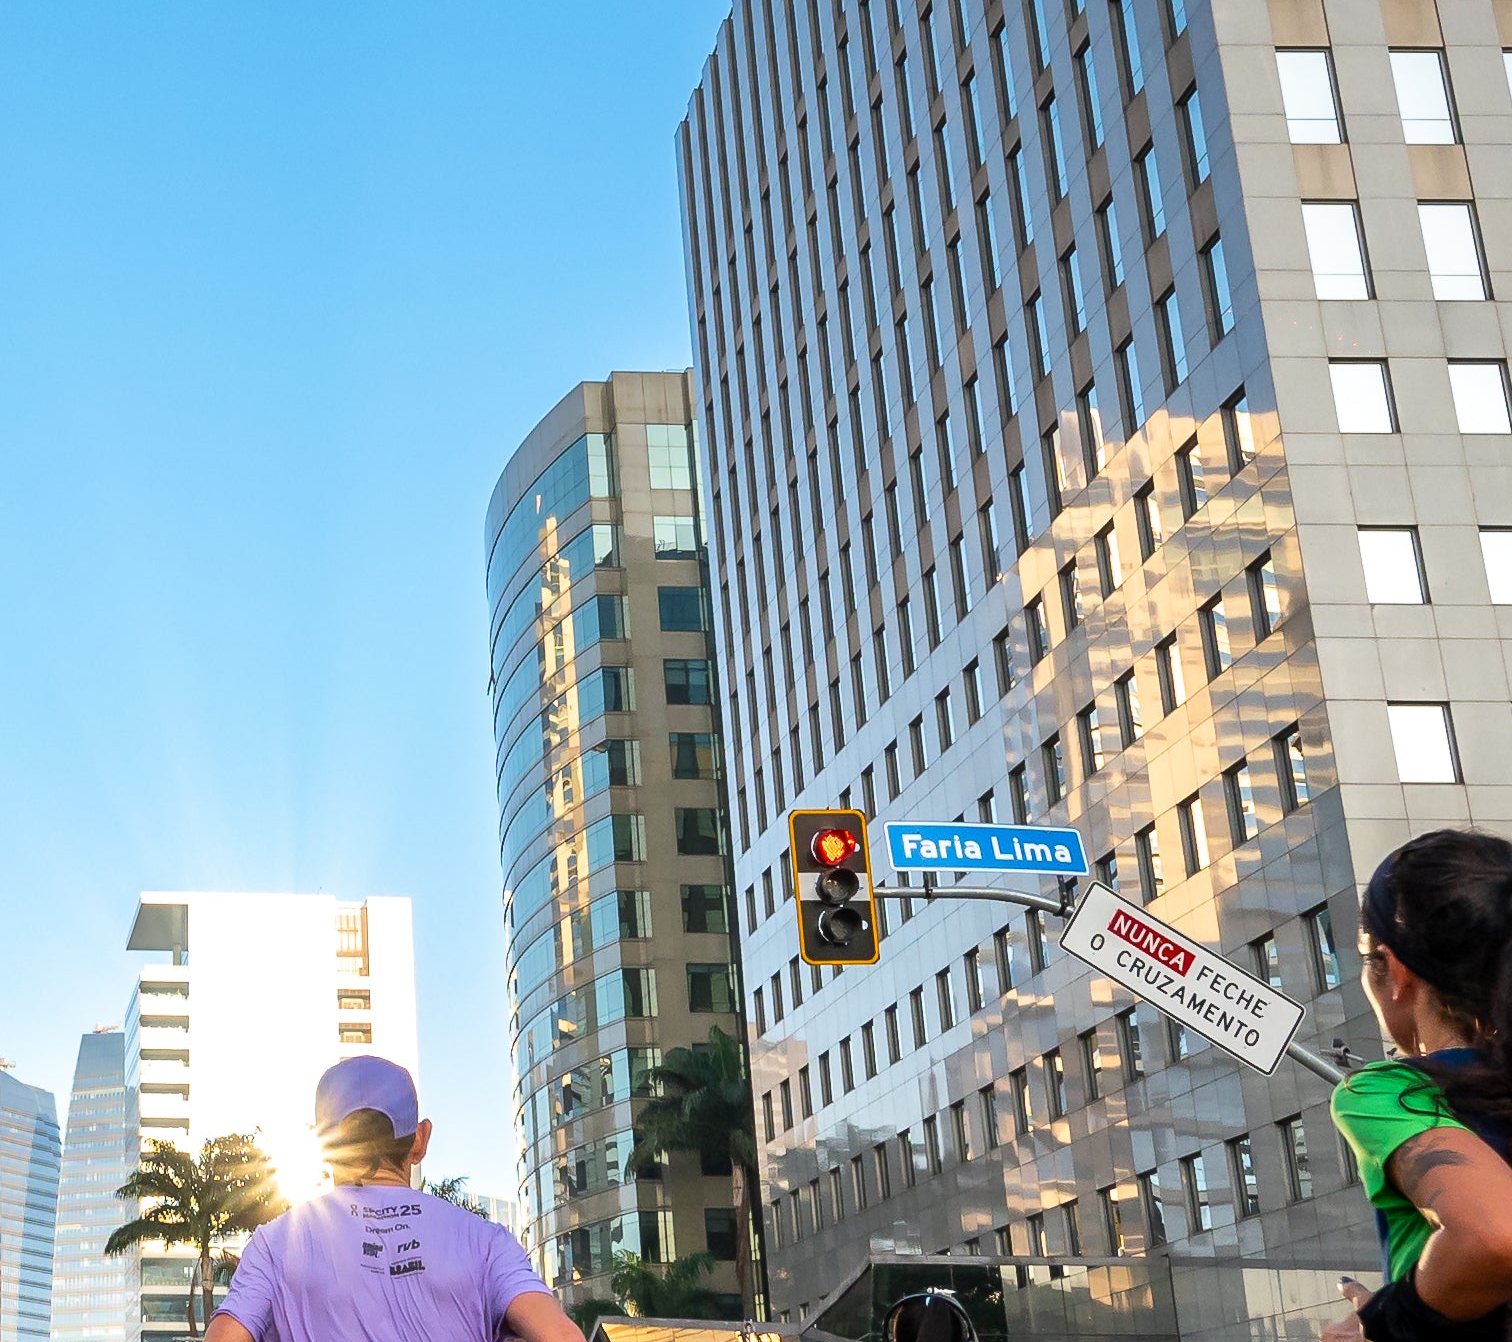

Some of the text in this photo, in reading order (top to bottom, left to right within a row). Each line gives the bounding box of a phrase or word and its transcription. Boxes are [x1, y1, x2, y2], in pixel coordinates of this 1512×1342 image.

[902, 833, 1072, 864] Faria Lima
[1114, 915, 1268, 1019] NUNCA FECHE
[1089, 932, 1260, 1049] O CRUZAMENTO
[399, 1204, 422, 1216] 25
[365, 1224, 394, 1234] Dream
[397, 1239, 421, 1254] rvb
